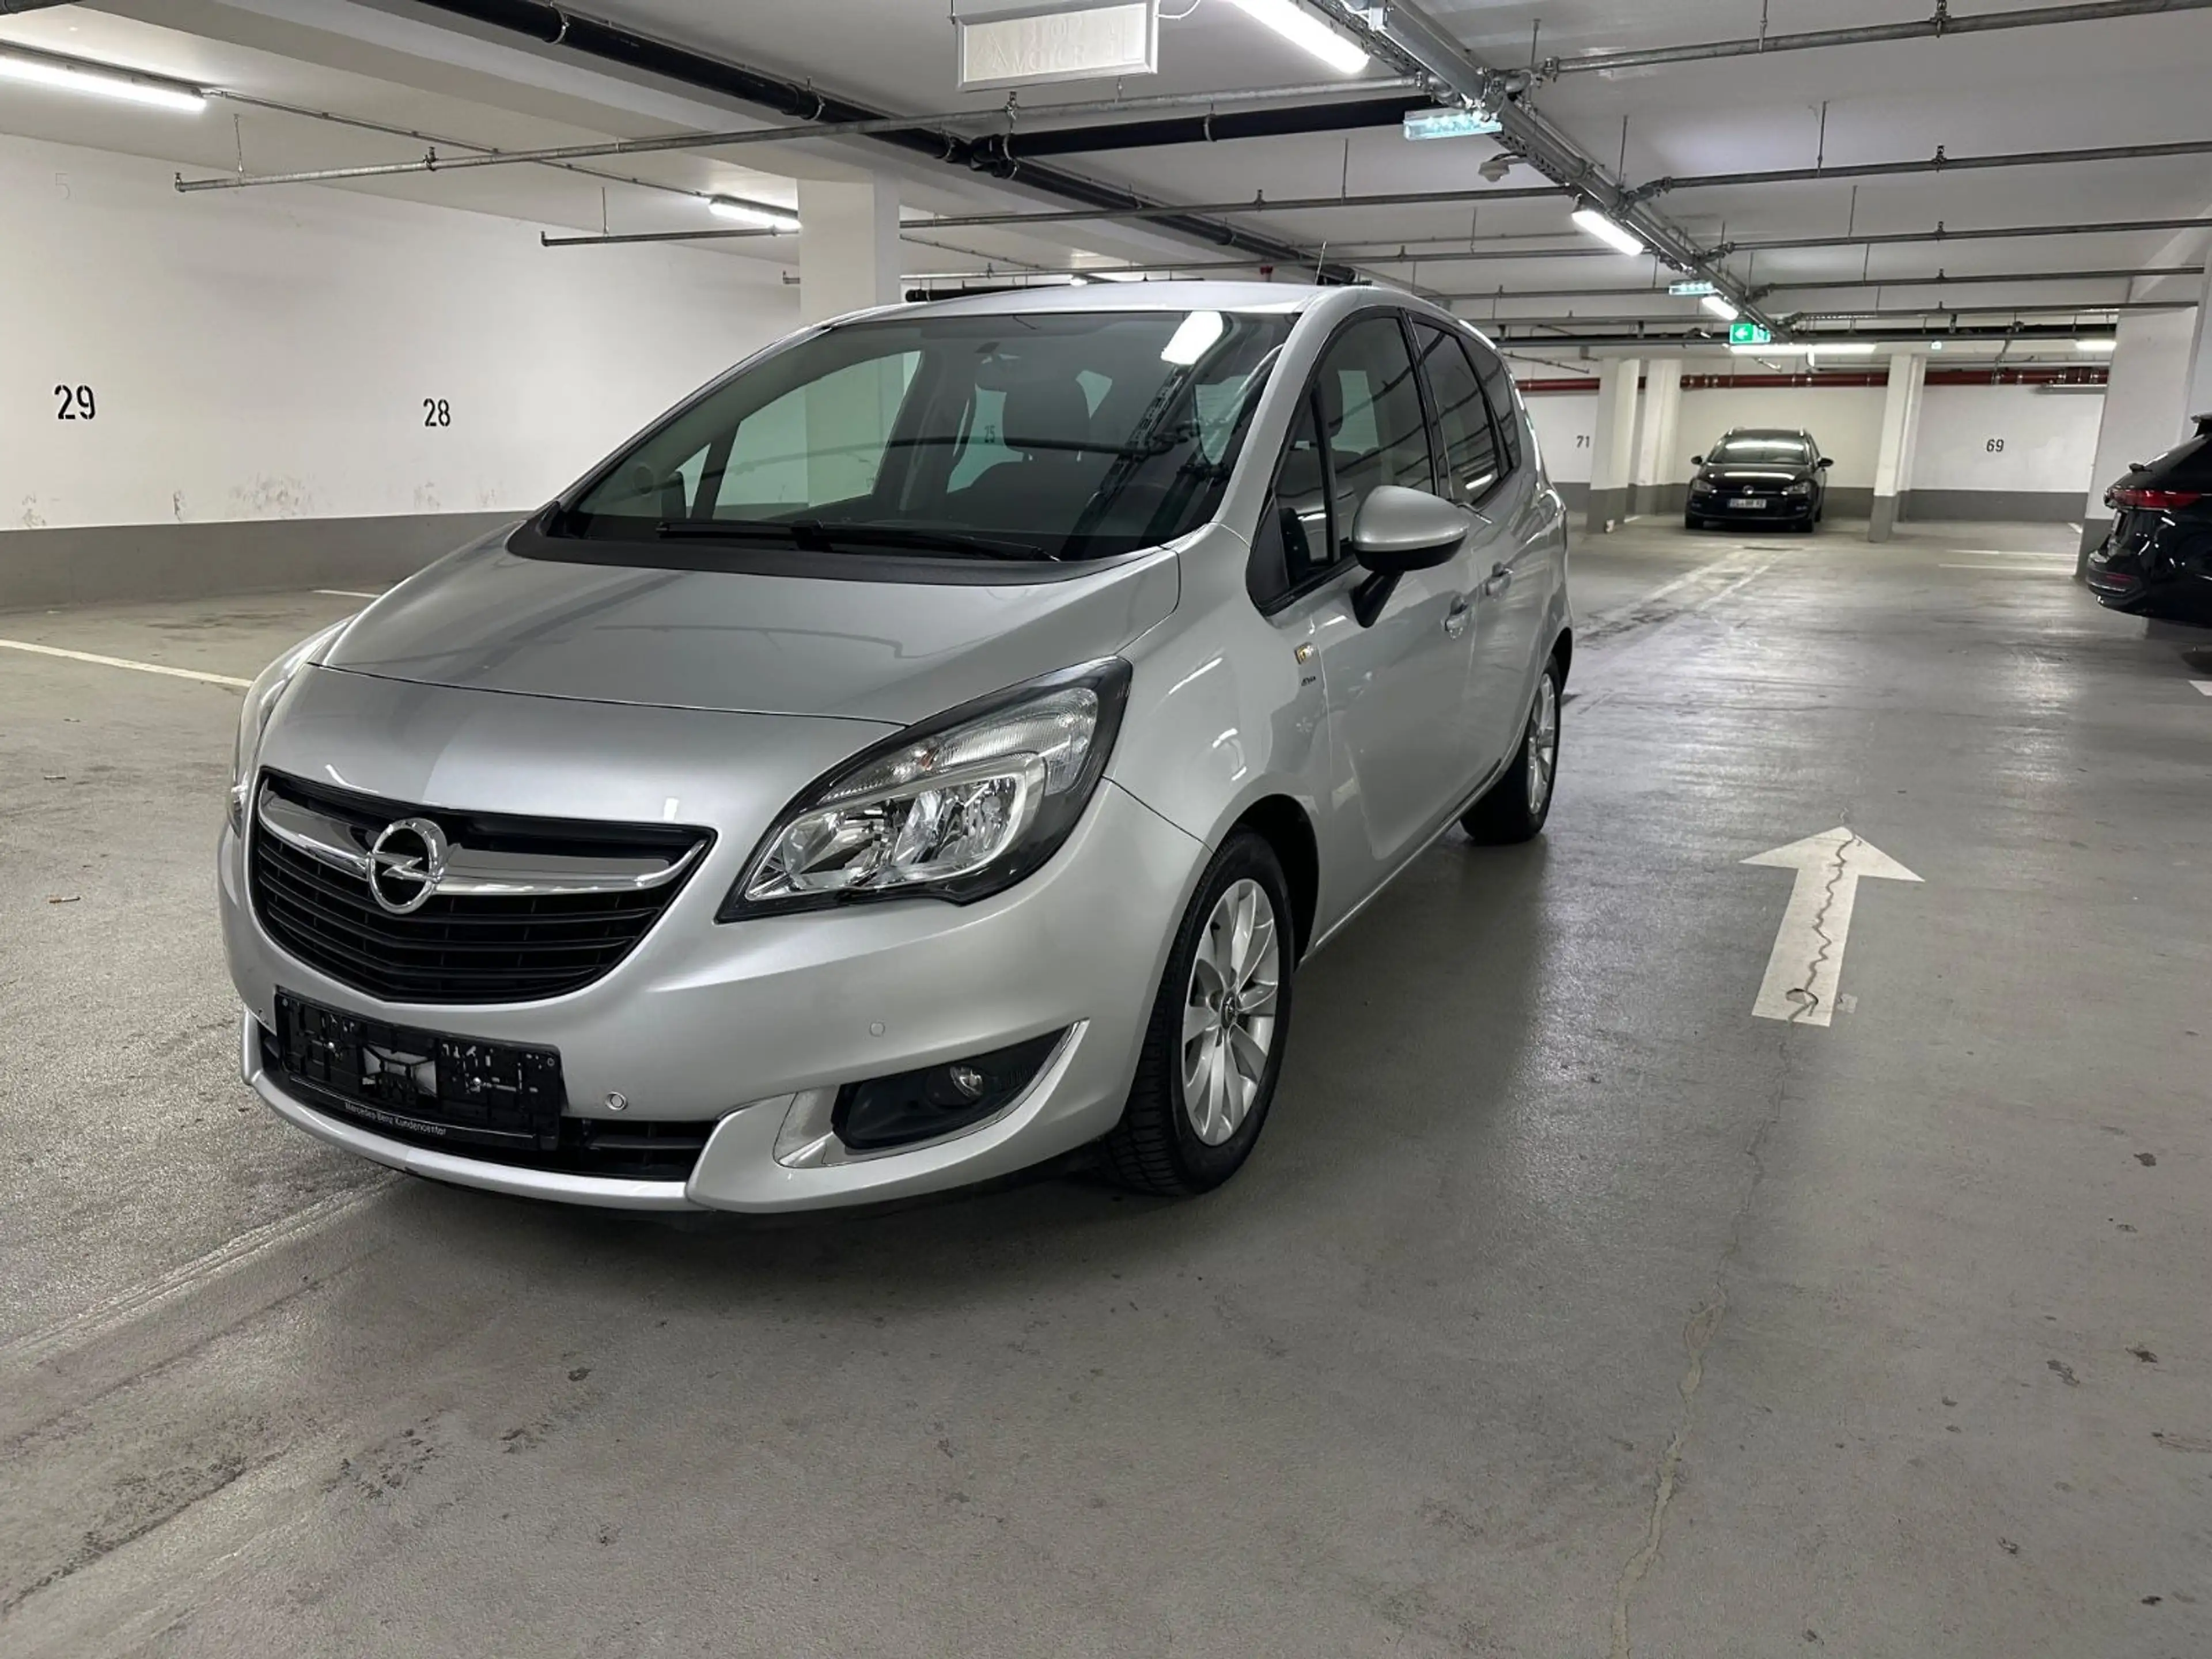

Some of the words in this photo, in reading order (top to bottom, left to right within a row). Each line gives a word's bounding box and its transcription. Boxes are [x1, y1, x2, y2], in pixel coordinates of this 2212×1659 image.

[54, 384, 95, 420] 29
[423, 398, 450, 427] 28
[1577, 435, 1590, 448] 71
[1987, 439, 2004, 452] 69
